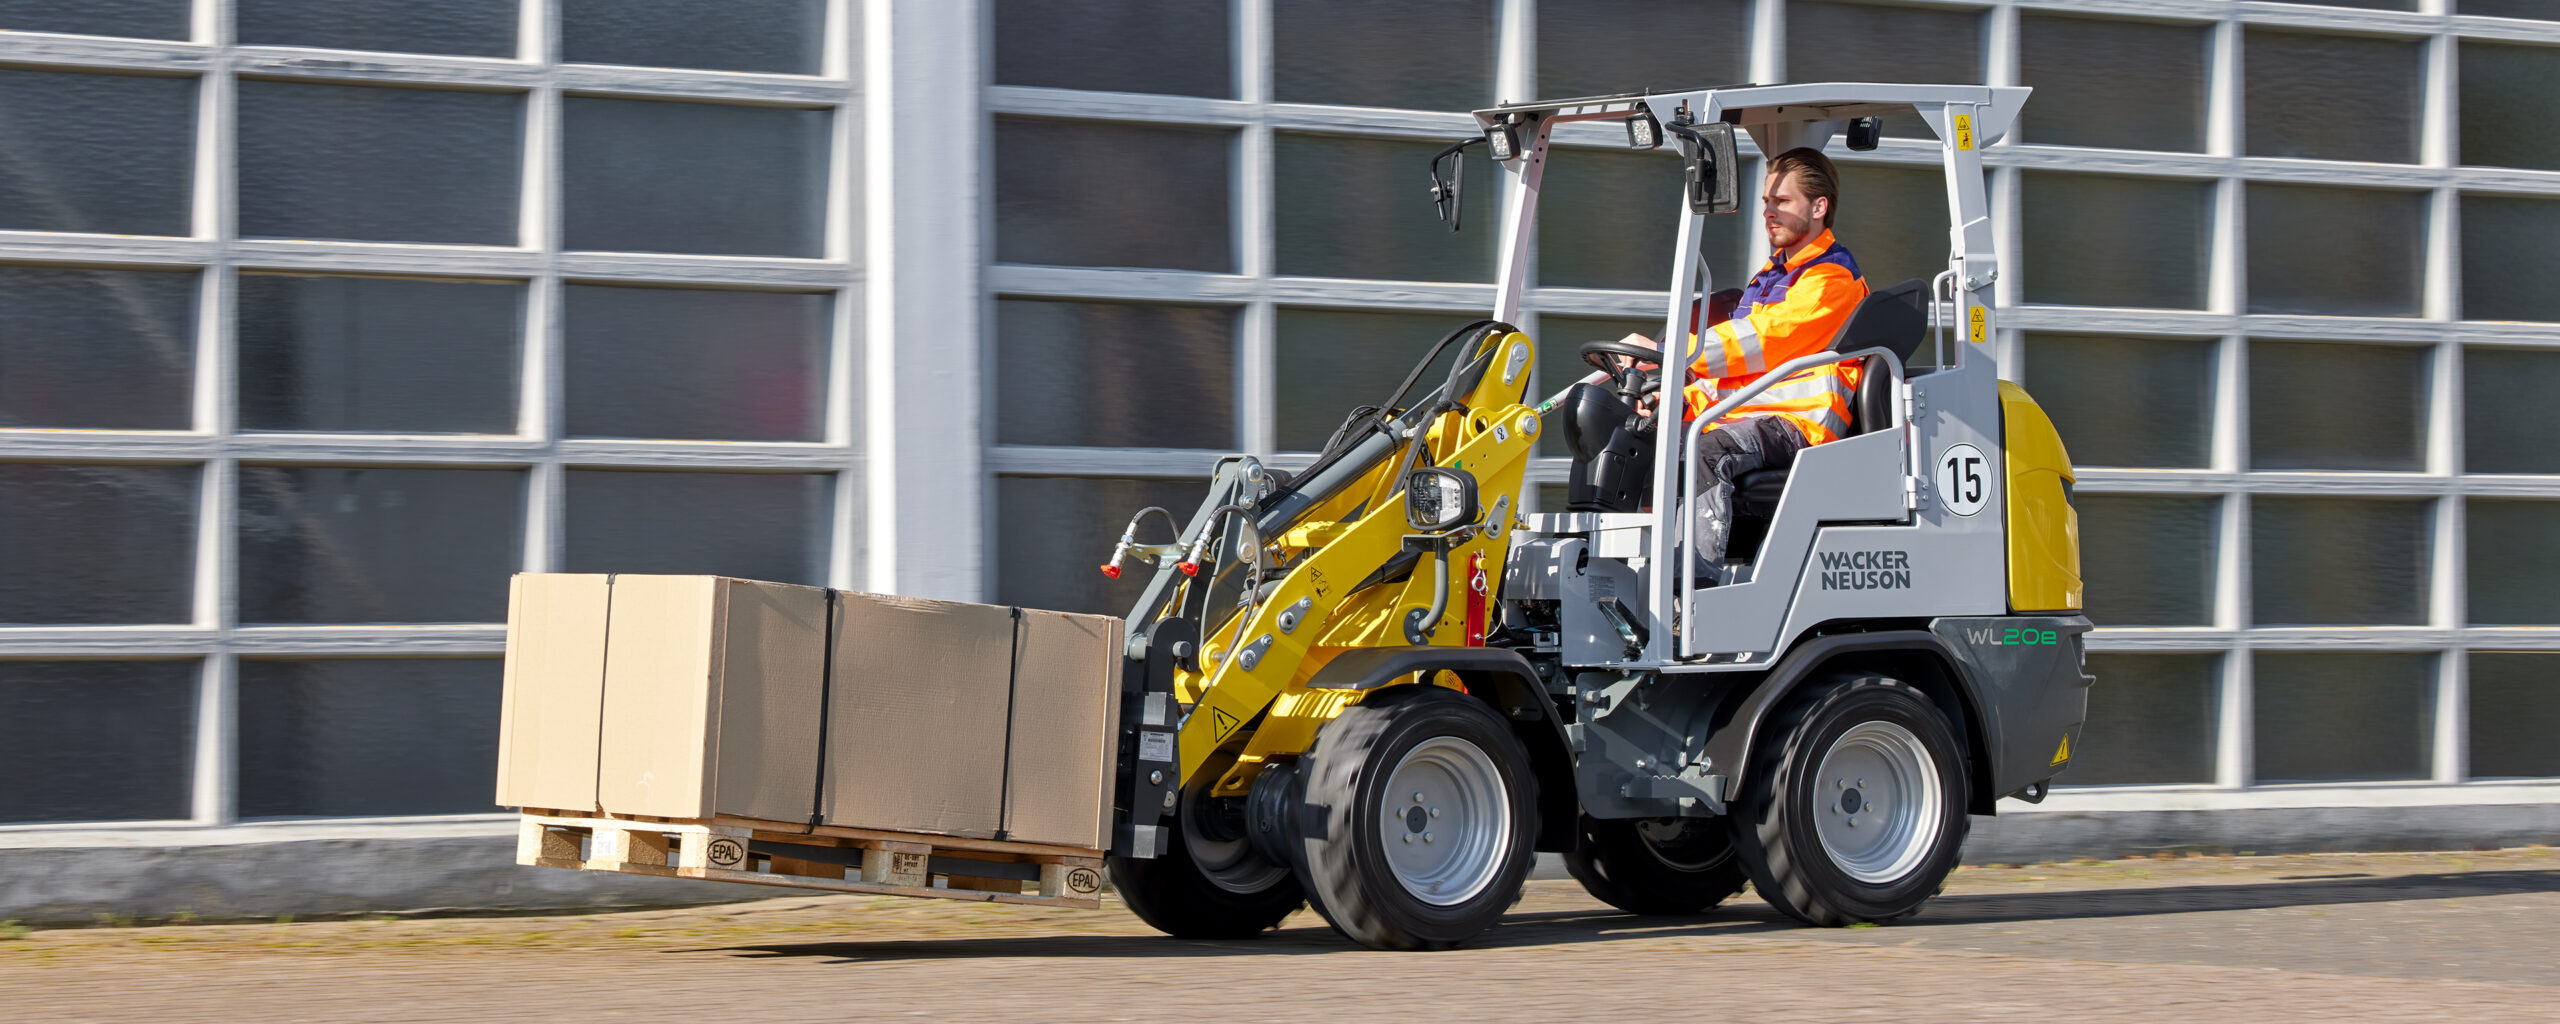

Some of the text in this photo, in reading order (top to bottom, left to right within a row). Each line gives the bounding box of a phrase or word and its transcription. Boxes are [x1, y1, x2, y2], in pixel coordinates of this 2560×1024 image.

[1947, 457, 1982, 503] 15
[1818, 551, 1910, 570] WACKER
[1821, 570, 1911, 590] NEUSON
[1966, 627, 2057, 646] WL20e
[712, 844, 738, 860] EPAL
[1072, 872, 1096, 889] EPAL
